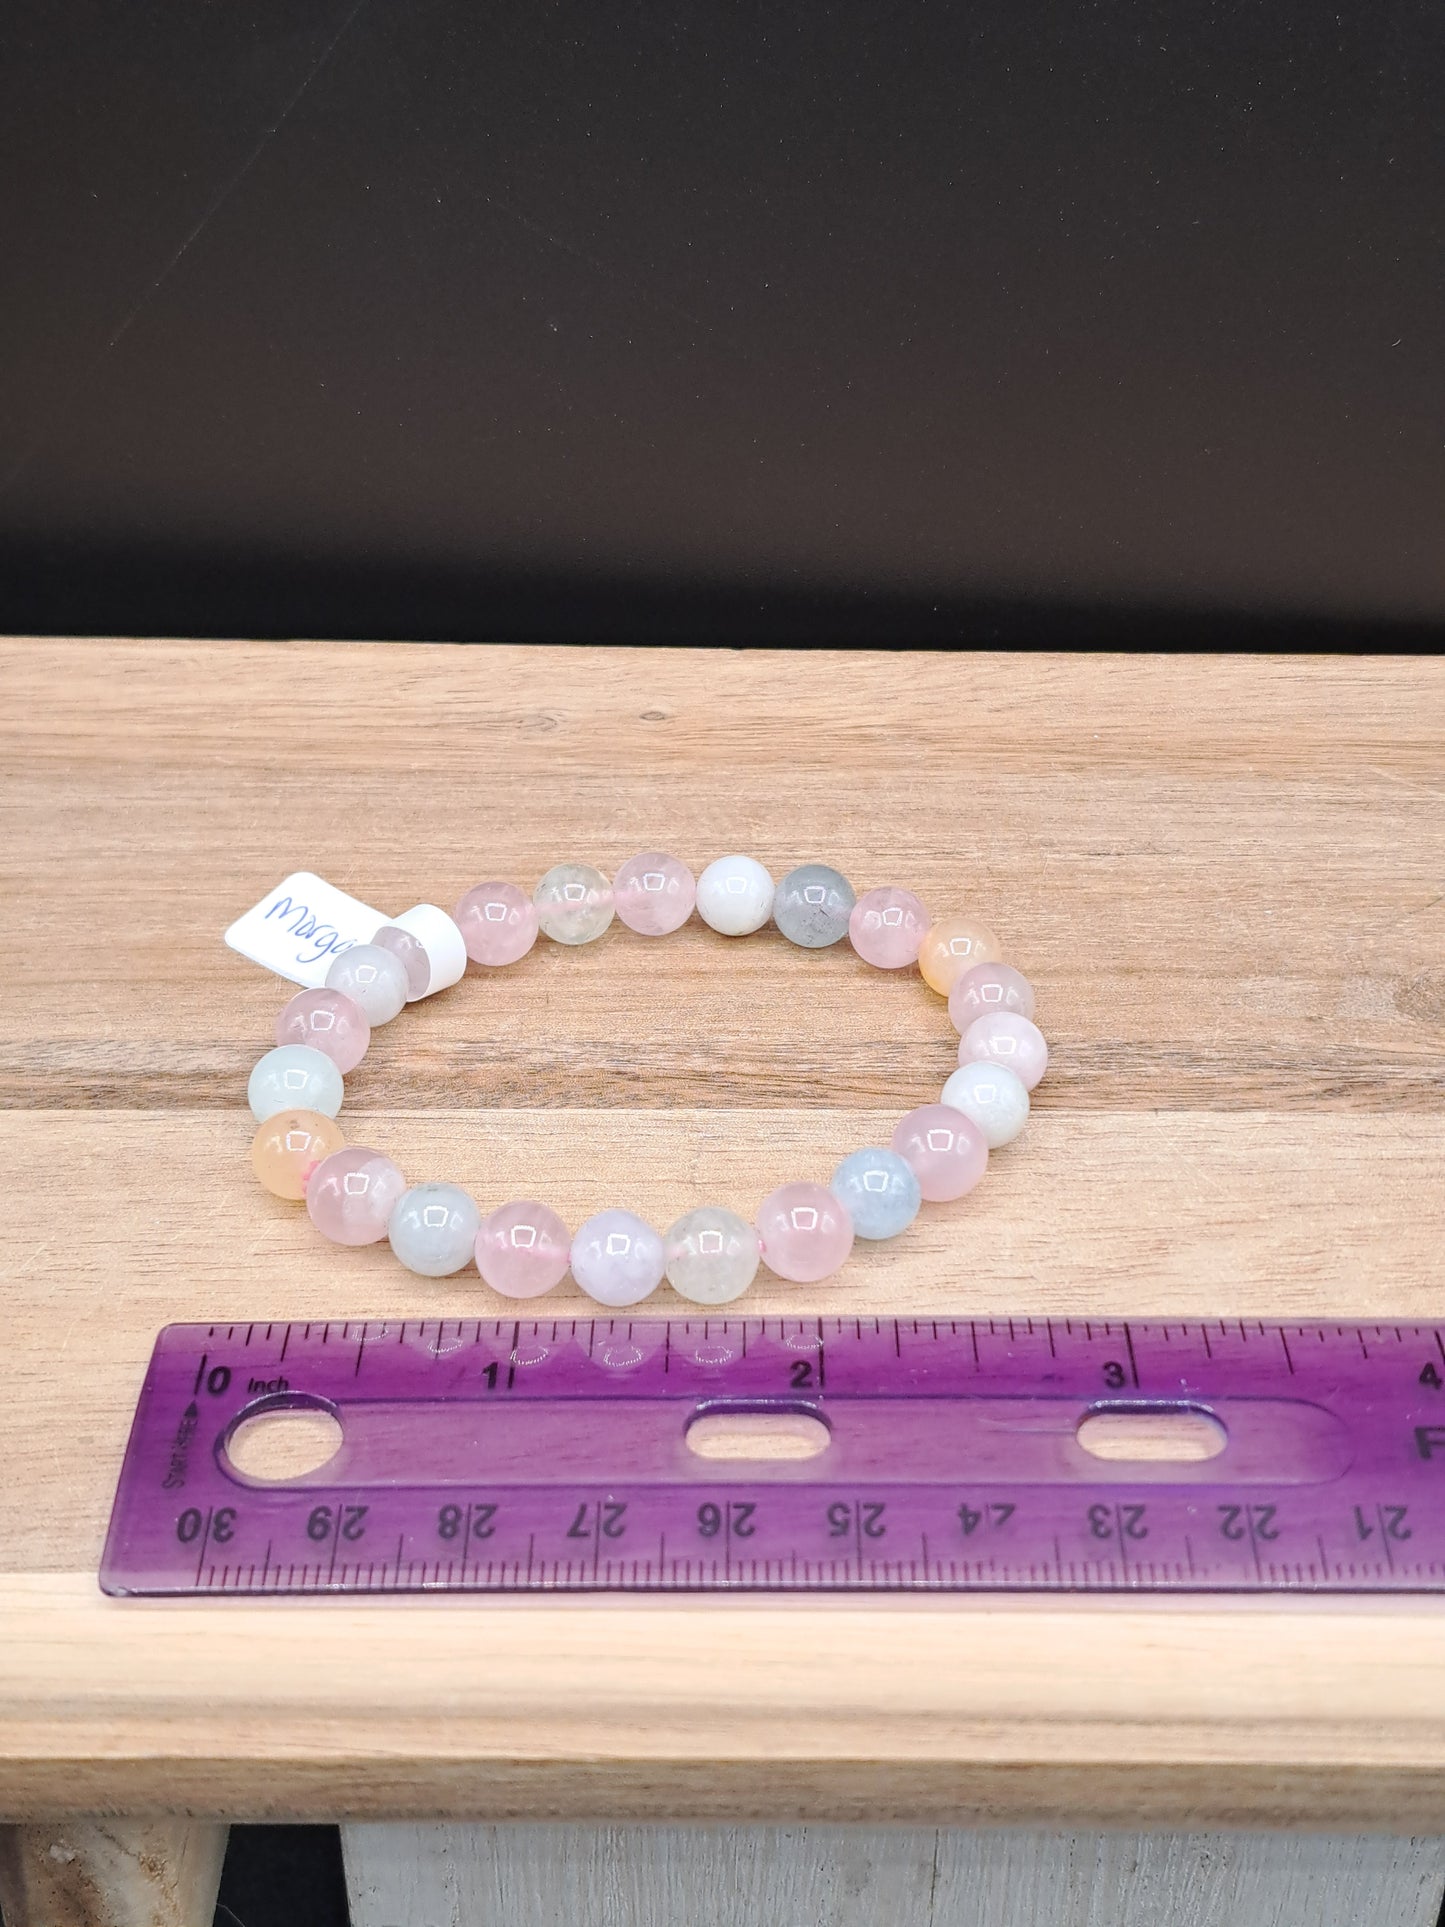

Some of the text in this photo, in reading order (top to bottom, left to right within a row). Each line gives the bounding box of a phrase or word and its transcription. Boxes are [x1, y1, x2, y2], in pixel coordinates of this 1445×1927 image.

[207, 1365, 232, 1395] 0
[482, 1362, 499, 1390] 1
[790, 1360, 814, 1389] 2
[1102, 1361, 1126, 1389] 3
[1419, 1362, 1443, 1390] 4
